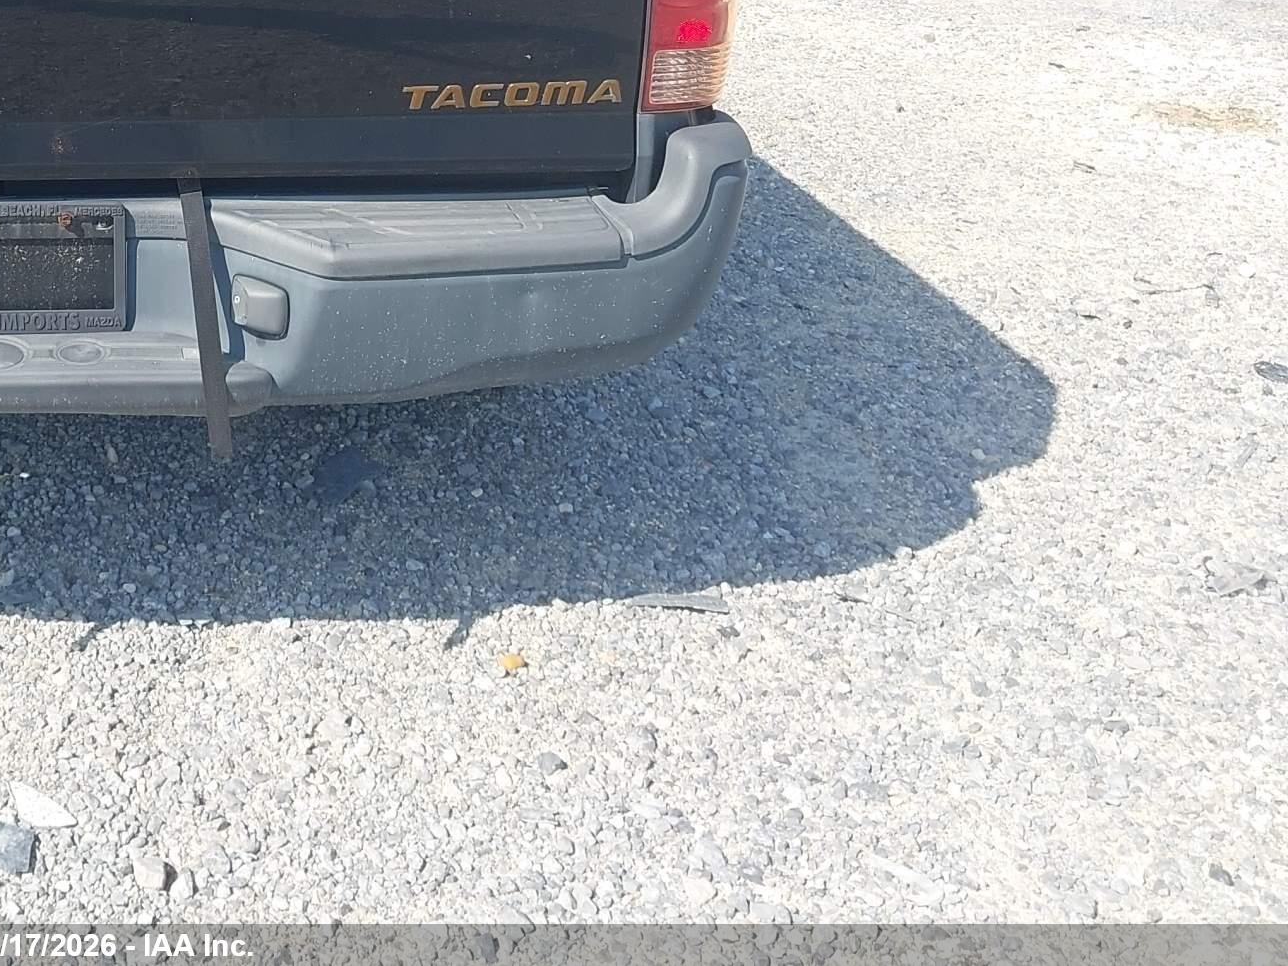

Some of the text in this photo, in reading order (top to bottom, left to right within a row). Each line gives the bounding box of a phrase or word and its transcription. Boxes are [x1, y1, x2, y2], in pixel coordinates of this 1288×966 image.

[402, 79, 623, 110] TACOMA
[74, 206, 123, 216] MERCEDES
[85, 316, 122, 328] MAZDA
